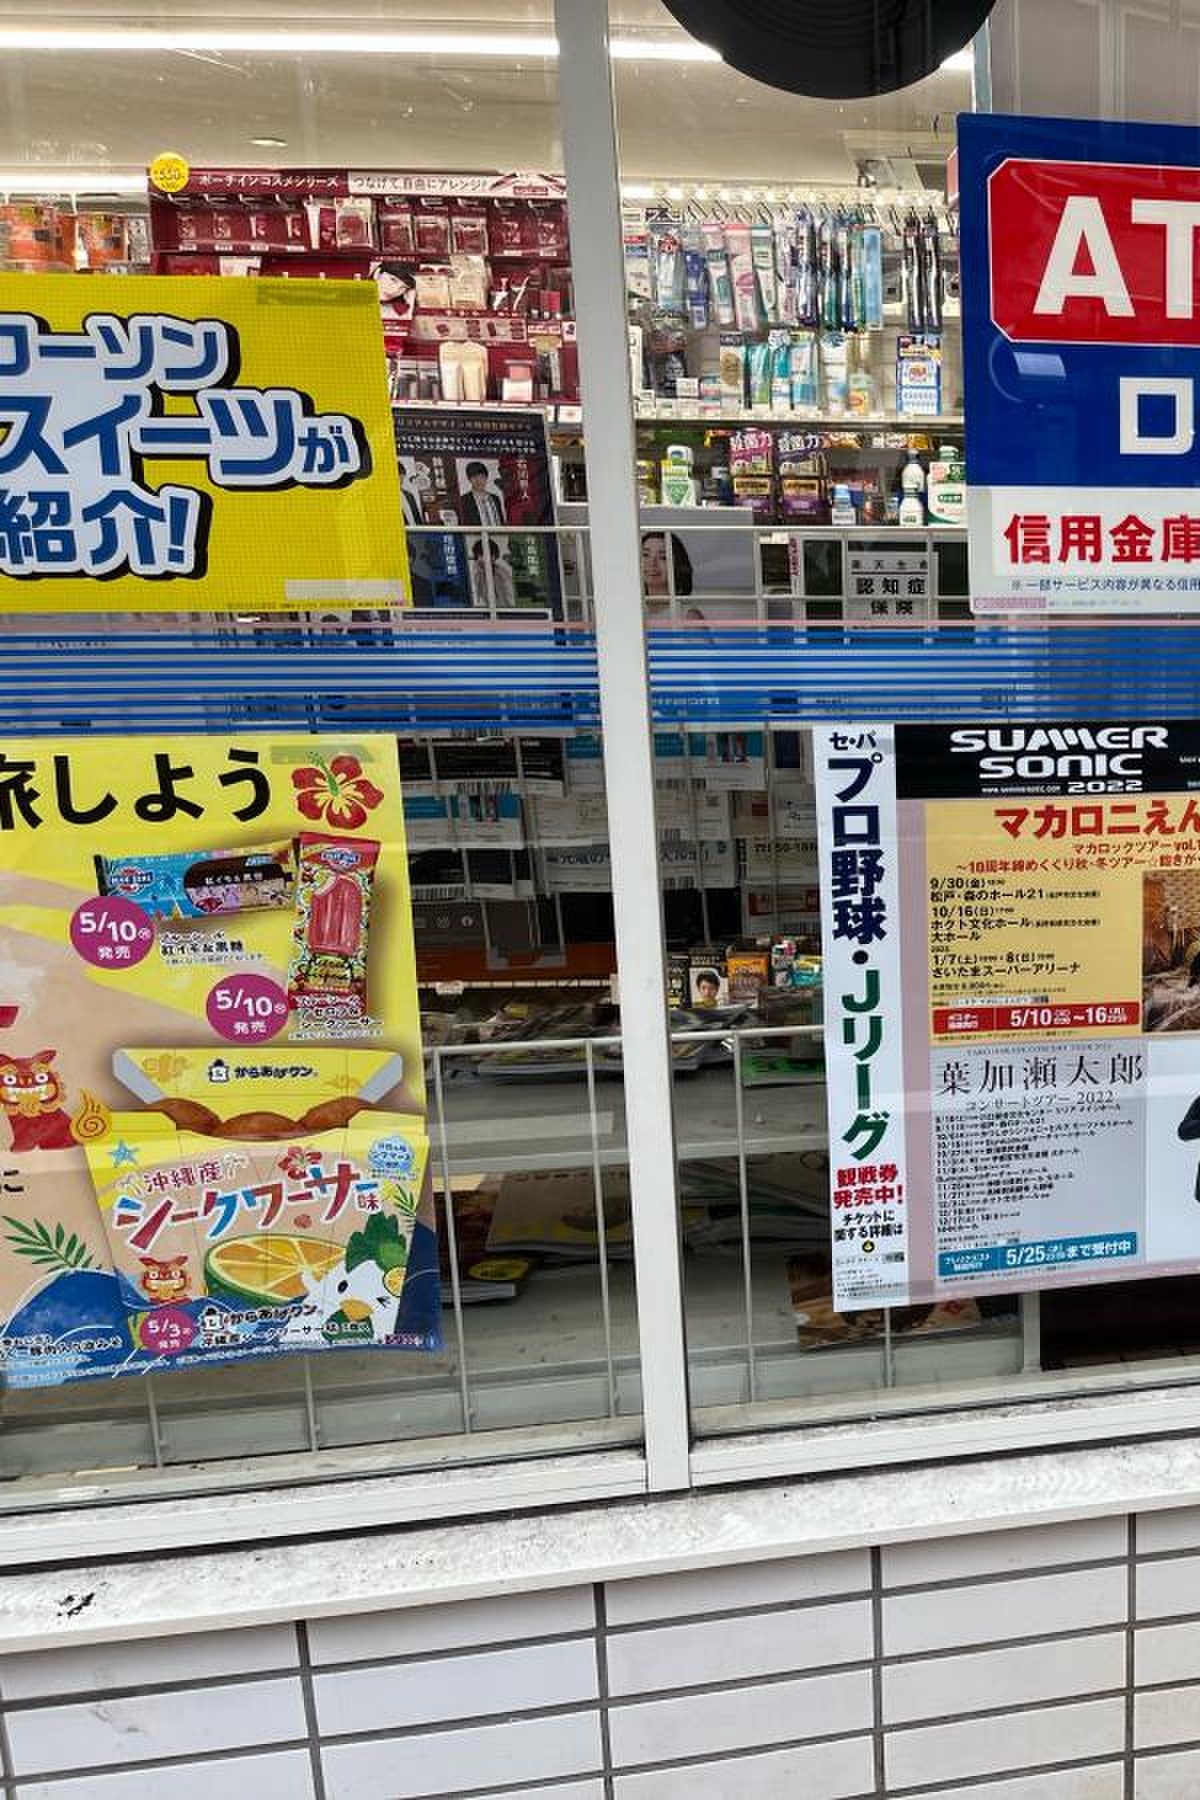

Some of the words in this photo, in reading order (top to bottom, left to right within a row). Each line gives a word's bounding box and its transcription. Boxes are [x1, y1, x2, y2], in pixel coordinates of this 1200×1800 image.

[0, 394, 348, 476] スイーツが
[856, 577, 926, 595] 認知症
[950, 726, 1169, 752] SUMMER
[979, 753, 1144, 780] SONIC
[1067, 779, 1144, 794] 2022
[79, 911, 137, 942] 5/10
[215, 989, 273, 1018] 5/10
[1010, 1008, 1051, 1027] 5/10
[939, 1052, 1144, 1097] 葉加瀬太郎
[1076, 1089, 1114, 1105] 2022
[833, 1185, 904, 1209] 発売中!
[1006, 1245, 1046, 1266] 5/25
